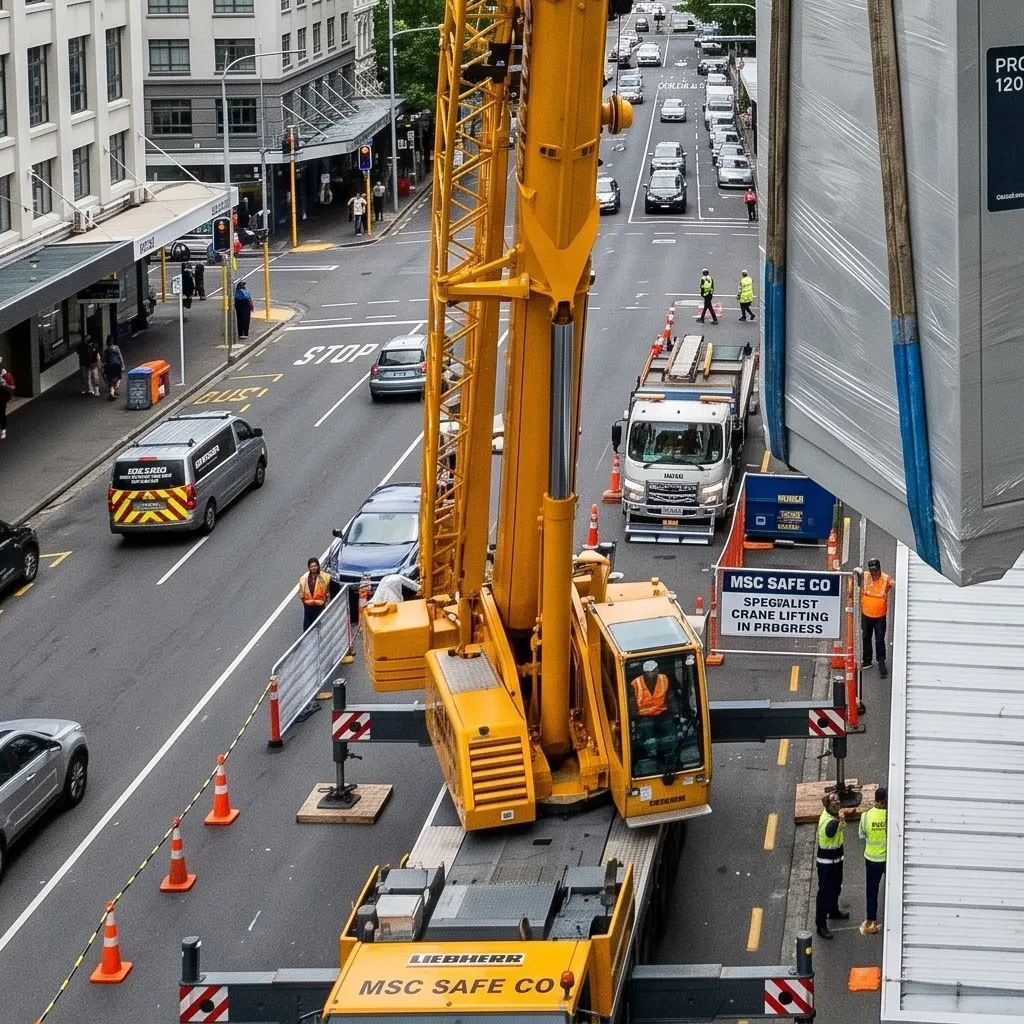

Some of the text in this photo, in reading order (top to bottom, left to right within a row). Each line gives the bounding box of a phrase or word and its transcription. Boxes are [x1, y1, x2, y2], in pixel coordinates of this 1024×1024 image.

[293, 343, 379, 366] STOP
[730, 575, 764, 589] MSC
[767, 577, 805, 591] SAFE
[731, 609, 829, 622] CRANE LIFTING
[737, 622, 750, 632] IN
[409, 954, 523, 964] LIEBHERR
[358, 978, 555, 995] MSC SAFE CO
